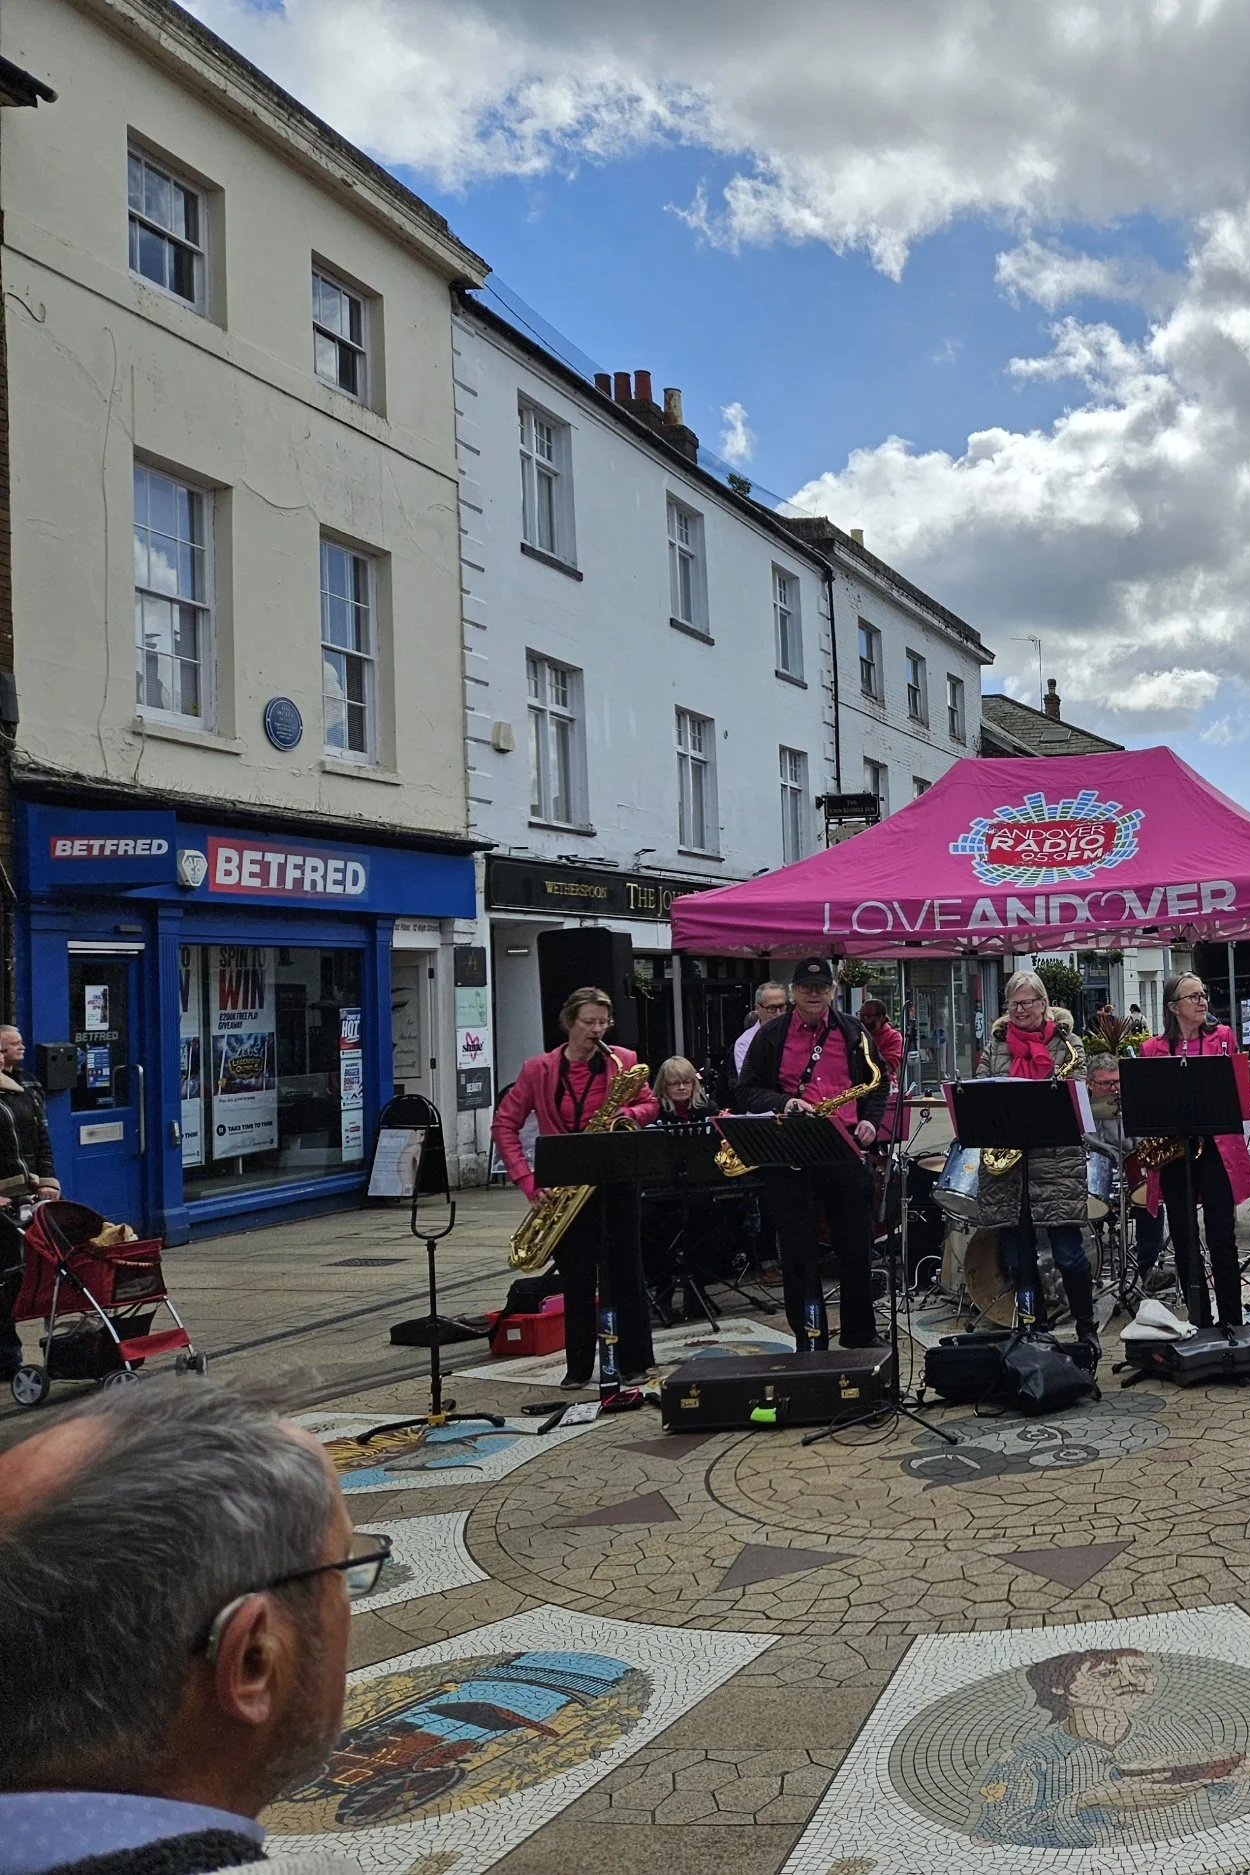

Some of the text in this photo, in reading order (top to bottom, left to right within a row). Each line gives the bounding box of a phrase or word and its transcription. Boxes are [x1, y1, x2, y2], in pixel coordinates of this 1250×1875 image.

[995, 825, 1106, 840] ANDOVER
[55, 839, 169, 856] BETFRED
[990, 834, 1105, 853] RADIO
[215, 847, 366, 895] BETFRED
[544, 881, 608, 899] WETHERSPOON
[626, 882, 656, 909] THE
[220, 945, 249, 969] SPIN
[219, 968, 266, 1010] WIN
[75, 1031, 119, 1042] BETFRED
[341, 1020, 360, 1038] HOT
[228, 1124, 241, 1132] TAKE
[242, 1123, 254, 1131] TIME
